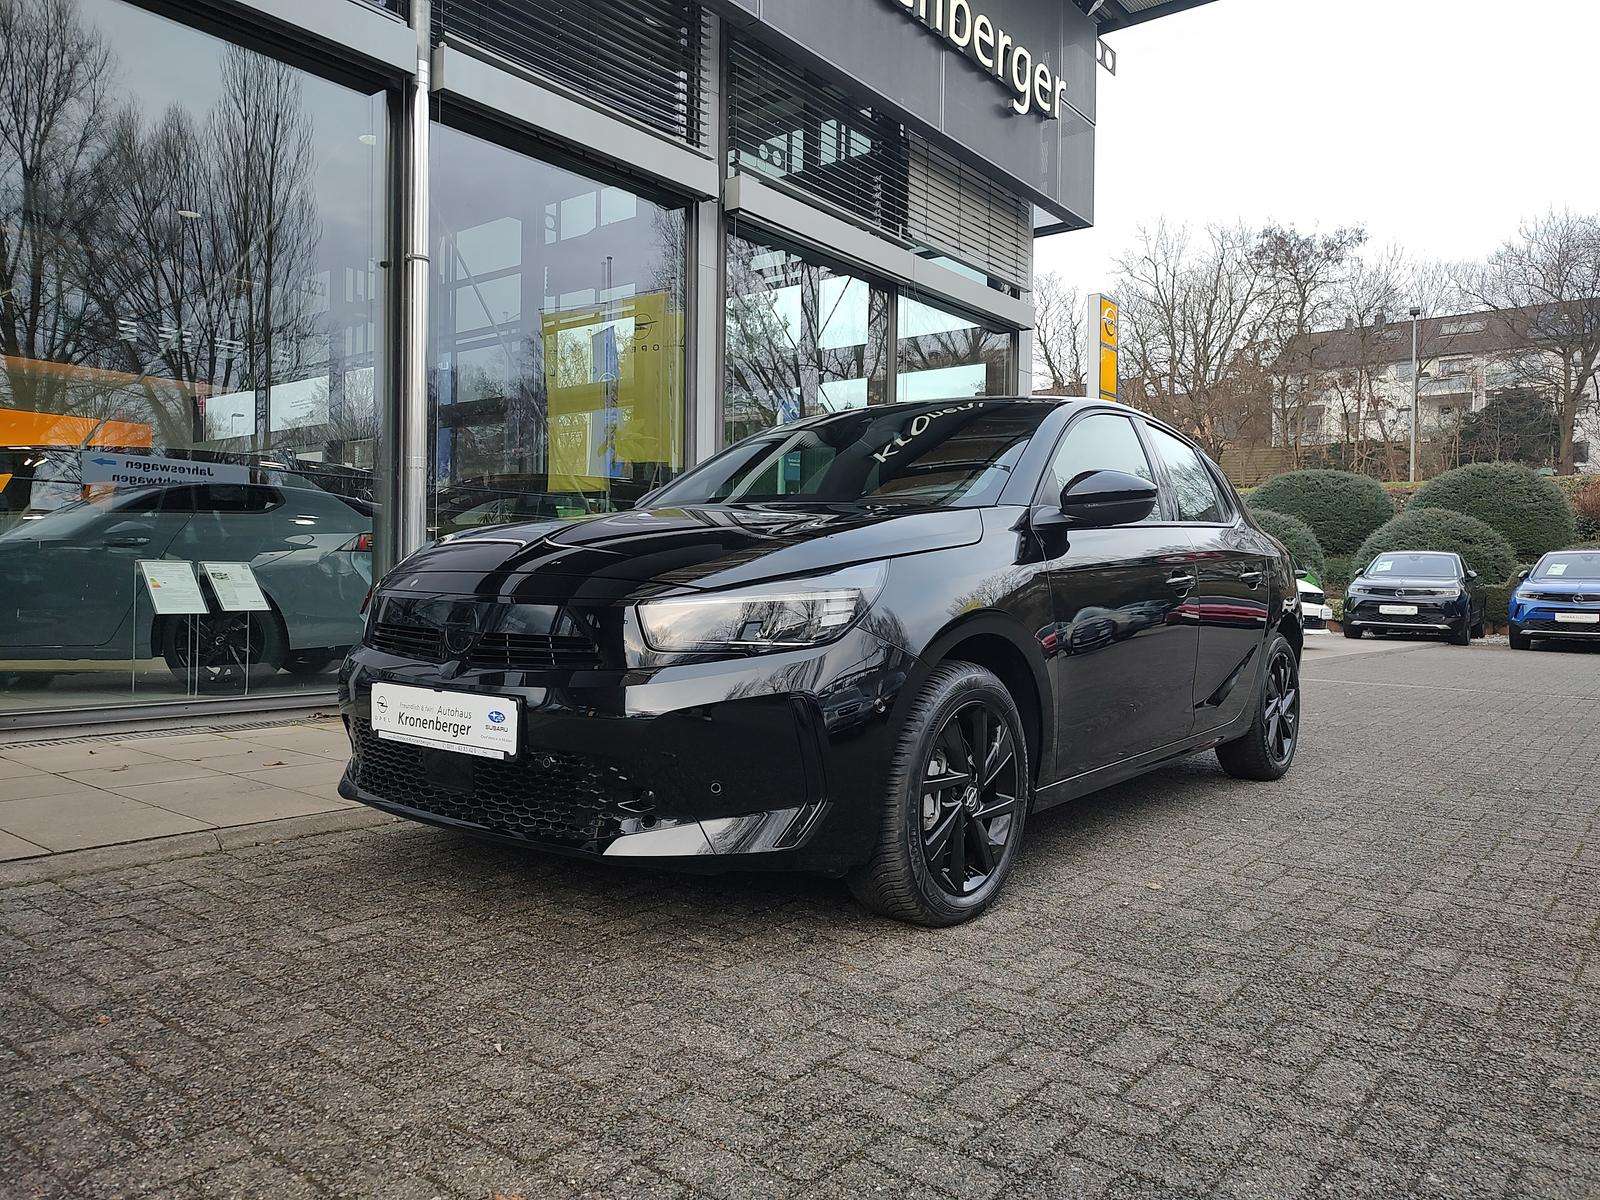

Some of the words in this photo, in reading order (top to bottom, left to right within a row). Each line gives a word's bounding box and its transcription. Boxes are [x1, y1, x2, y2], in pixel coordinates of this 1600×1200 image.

[437, 705, 472, 719] Autohaus
[375, 715, 391, 723] OPEL
[397, 711, 472, 737] Kronenberger
[485, 724, 509, 733] SUBARU
